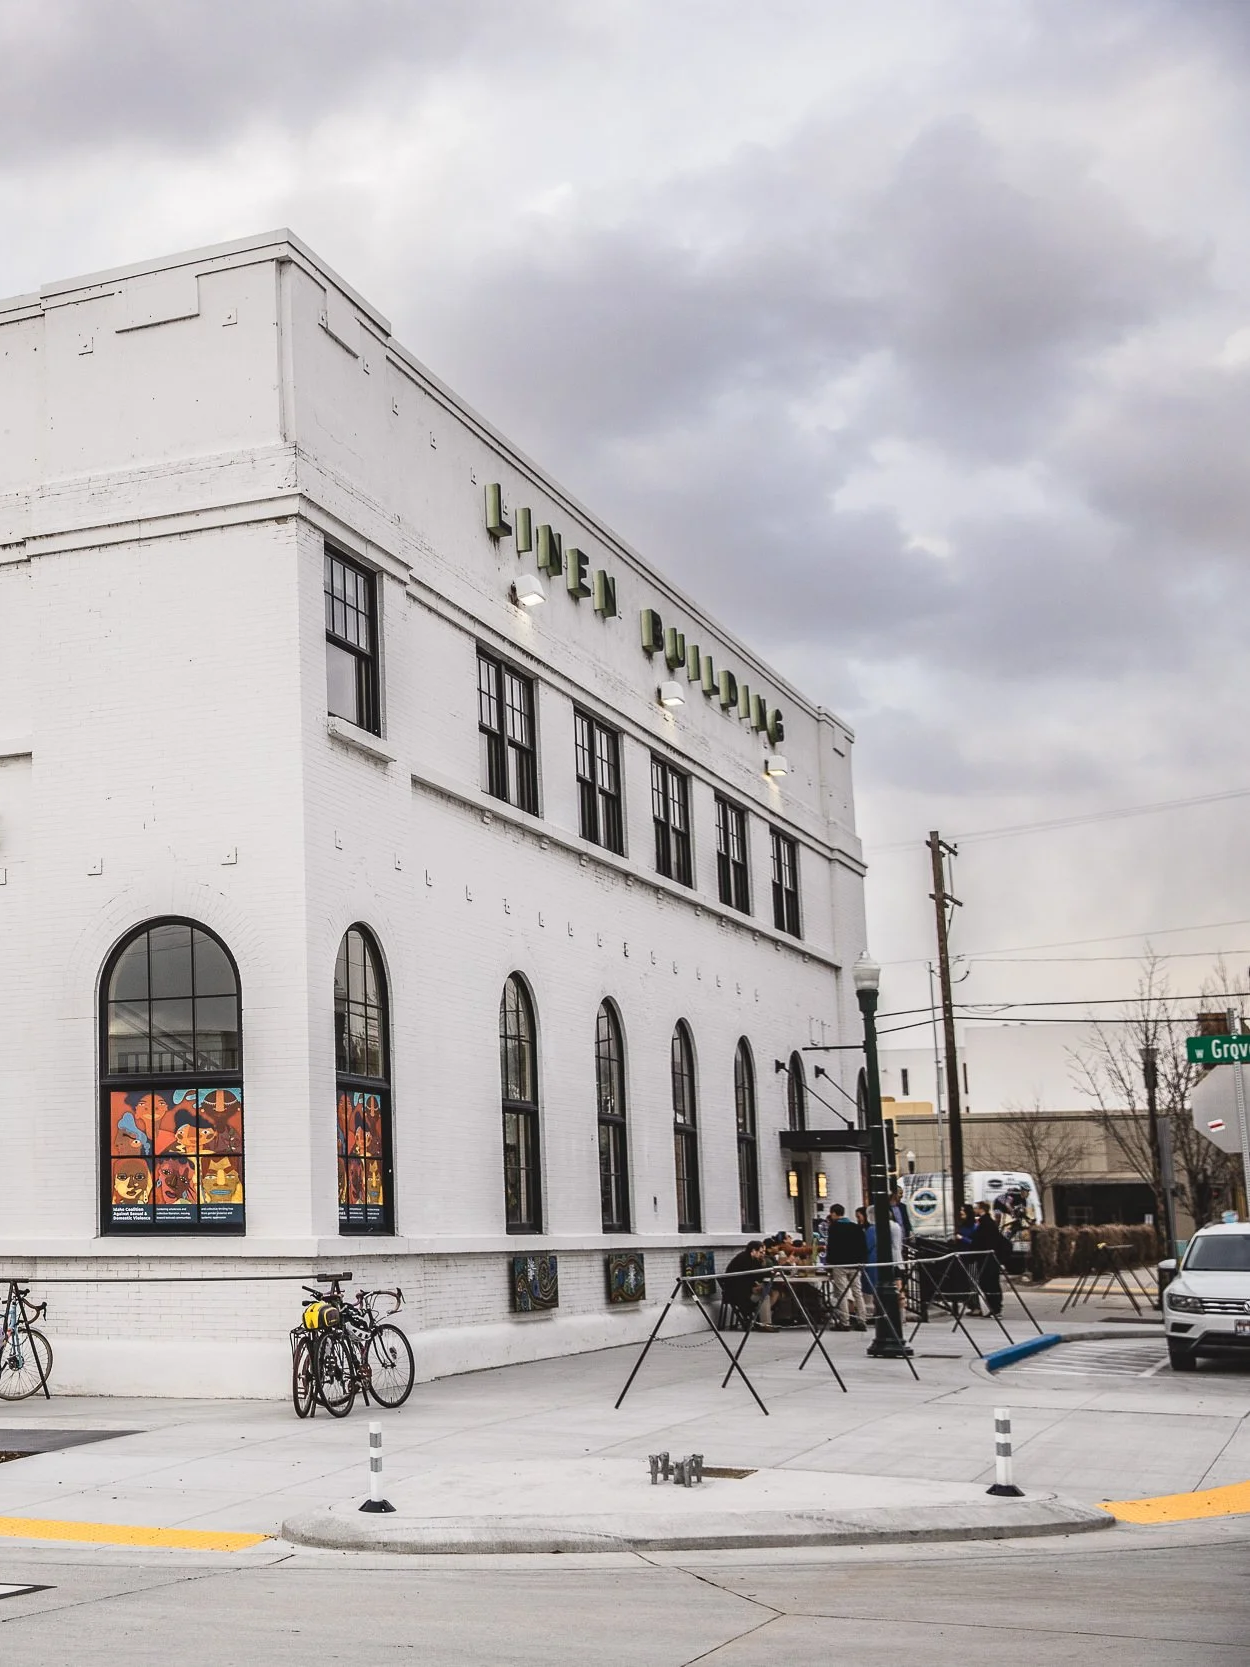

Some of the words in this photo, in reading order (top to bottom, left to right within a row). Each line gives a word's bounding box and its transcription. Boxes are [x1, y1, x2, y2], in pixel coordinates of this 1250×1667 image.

[485, 483, 616, 617] LINEN
[640, 608, 784, 743] BUILDING
[1195, 1049, 1204, 1059] W
[1211, 1039, 1250, 1059] Grov
